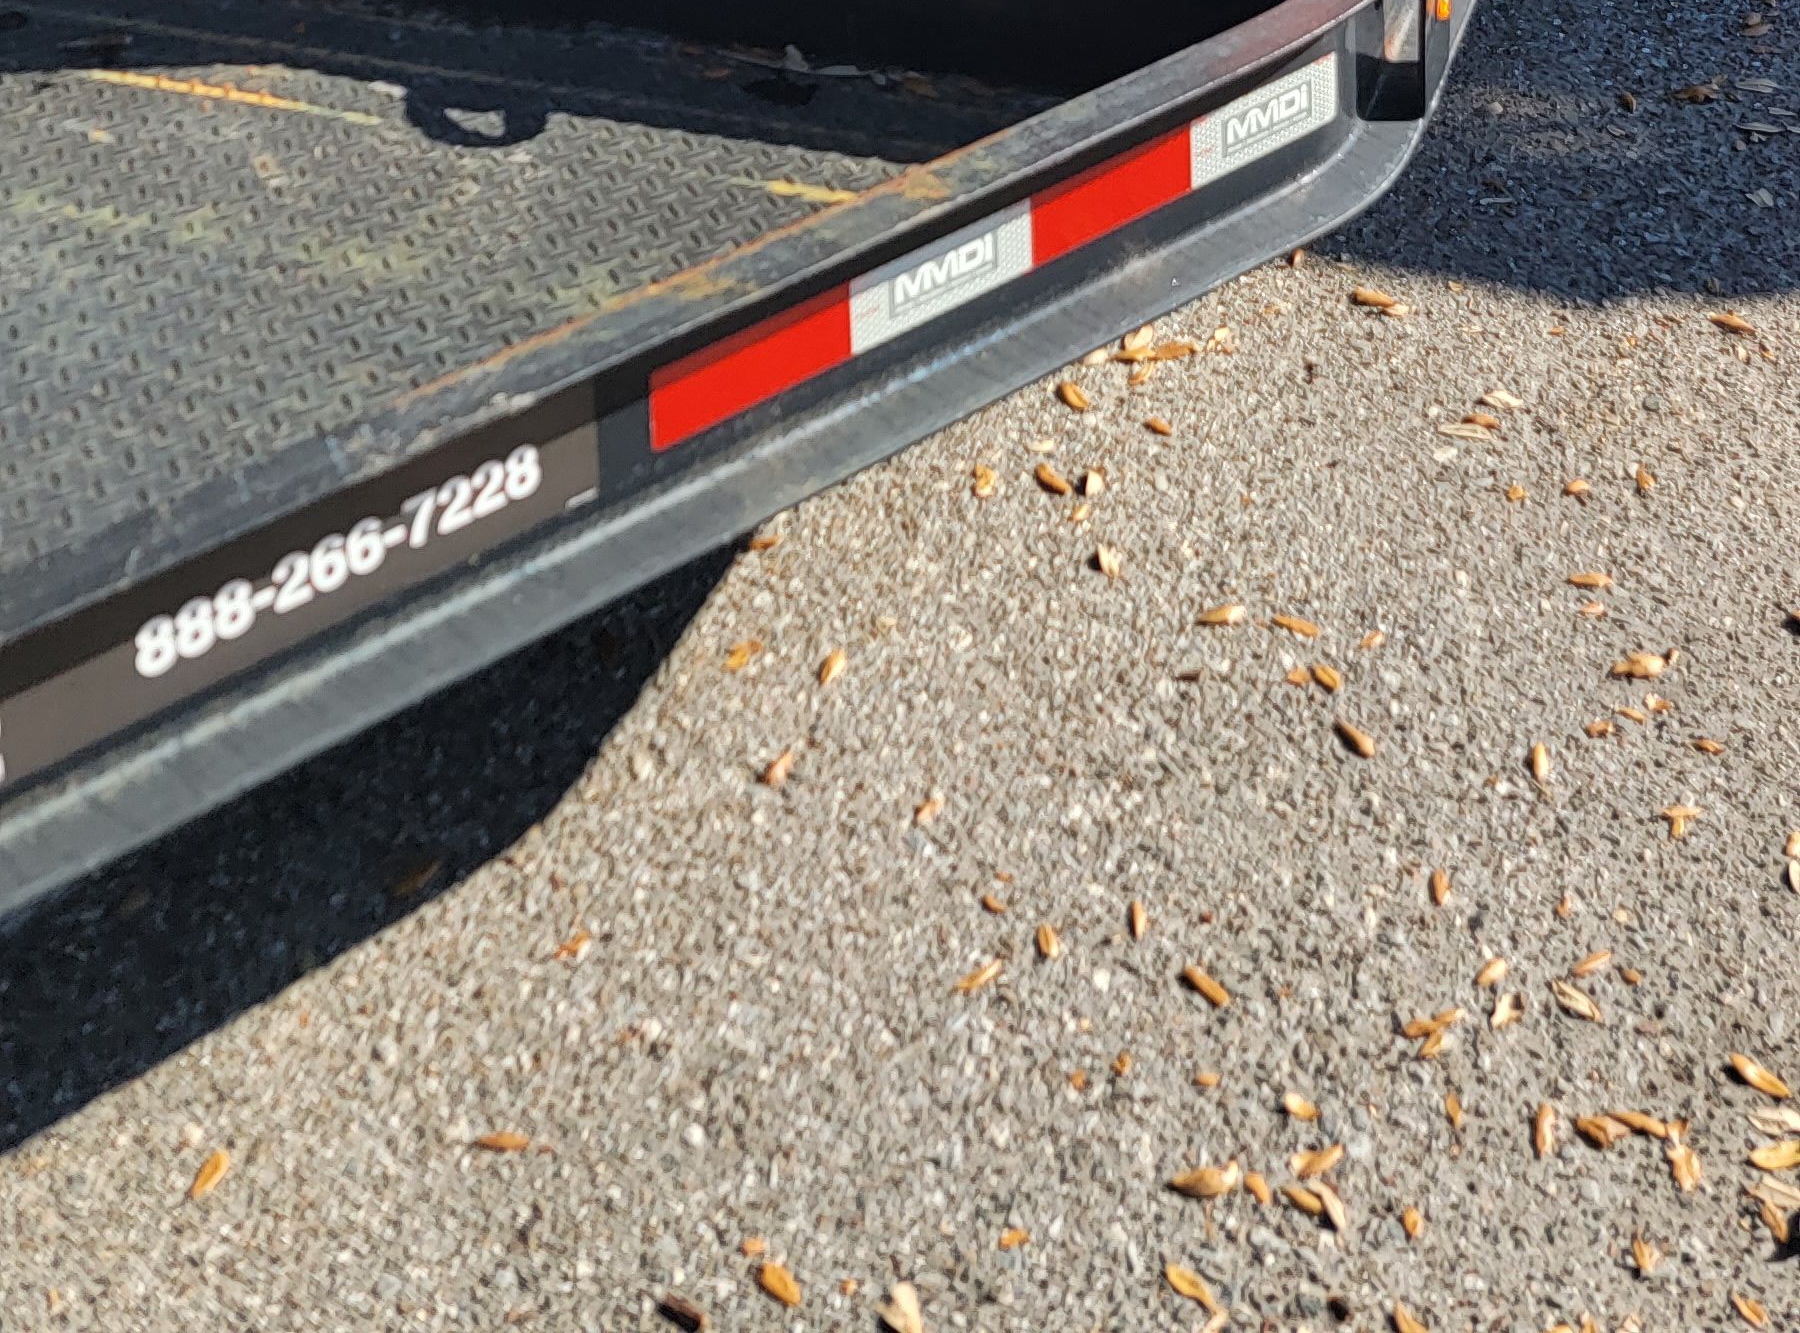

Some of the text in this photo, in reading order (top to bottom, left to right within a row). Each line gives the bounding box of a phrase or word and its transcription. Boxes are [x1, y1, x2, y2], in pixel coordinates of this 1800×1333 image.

[1226, 83, 1307, 145] MMDI
[894, 232, 993, 304] MMDI
[134, 444, 543, 678] 888-266-7228
